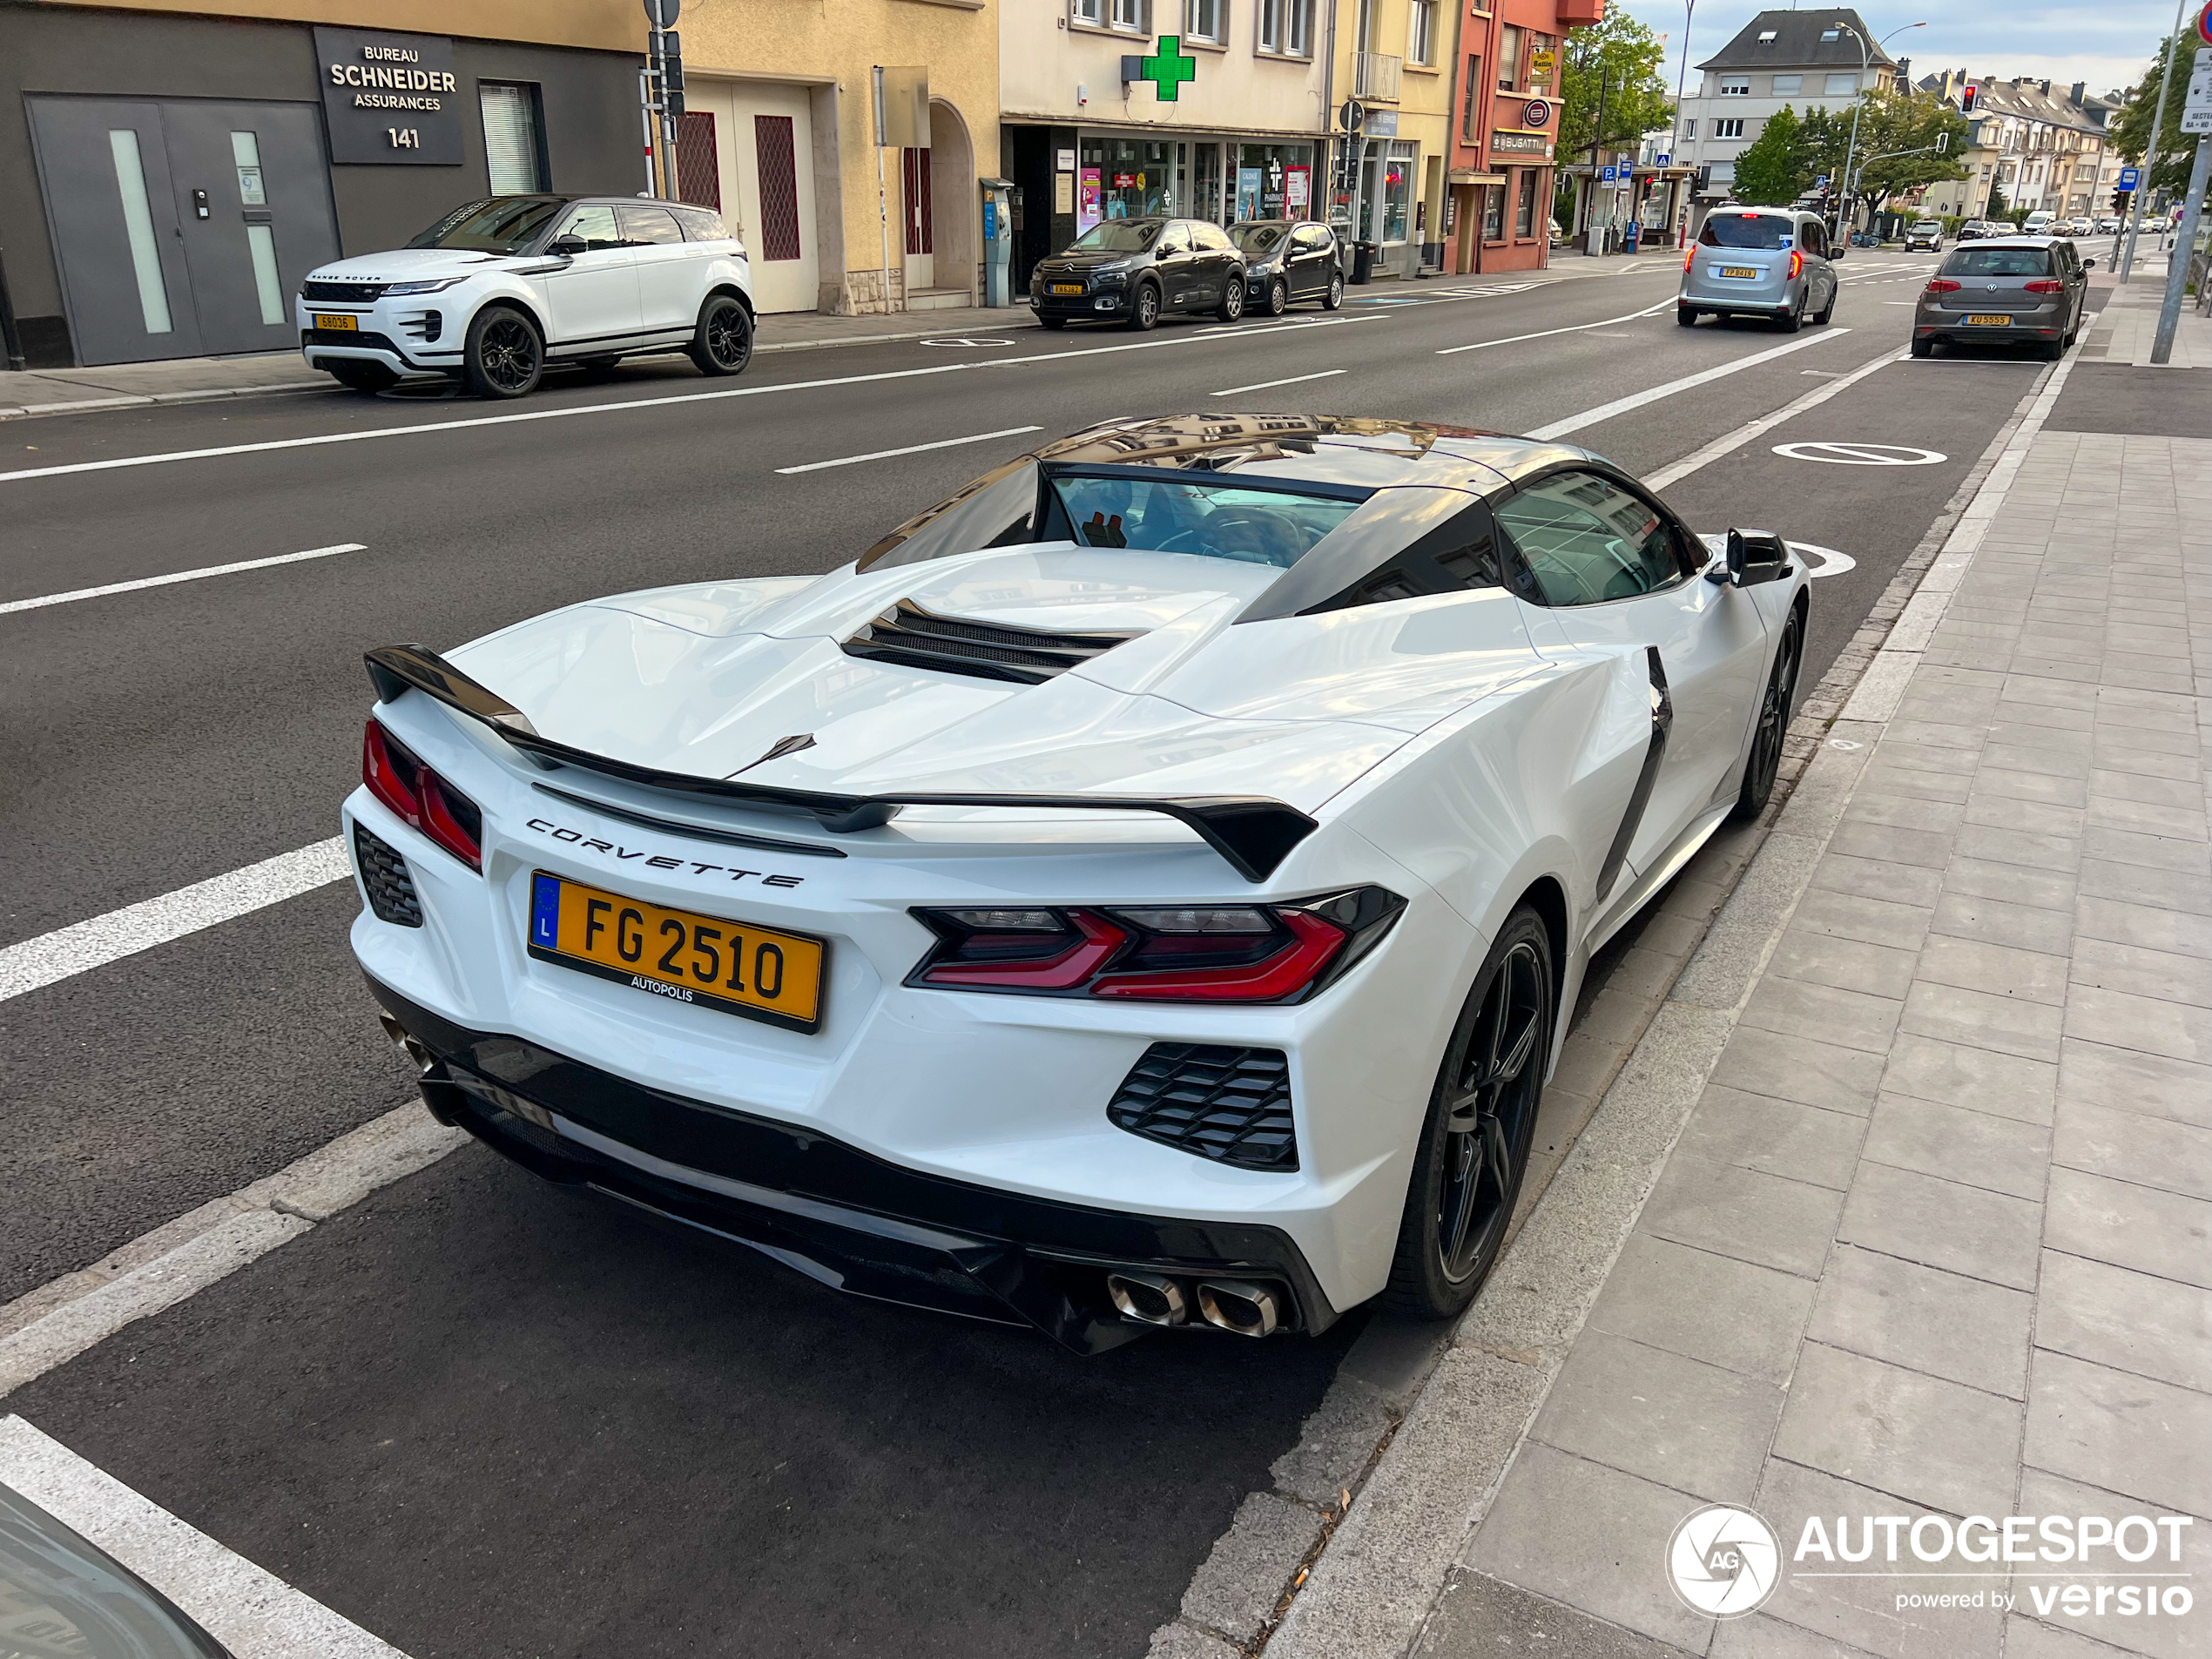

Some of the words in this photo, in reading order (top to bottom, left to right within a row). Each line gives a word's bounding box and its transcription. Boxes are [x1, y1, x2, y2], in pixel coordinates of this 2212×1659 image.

[364, 46, 419, 63] BUREAU
[331, 64, 456, 92] SCHNEIDER
[355, 93, 441, 111] ASSURANCES
[388, 128, 420, 148] 141
[1507, 138, 1540, 149] BUGATTI
[987, 190, 993, 201] P
[322, 316, 348, 328] 68036
[526, 818, 805, 888] CORVETTE
[541, 918, 550, 937] L
[585, 898, 644, 963] FG
[658, 919, 784, 1000] 2510
[631, 975, 693, 1002] AUTOPOLIS
